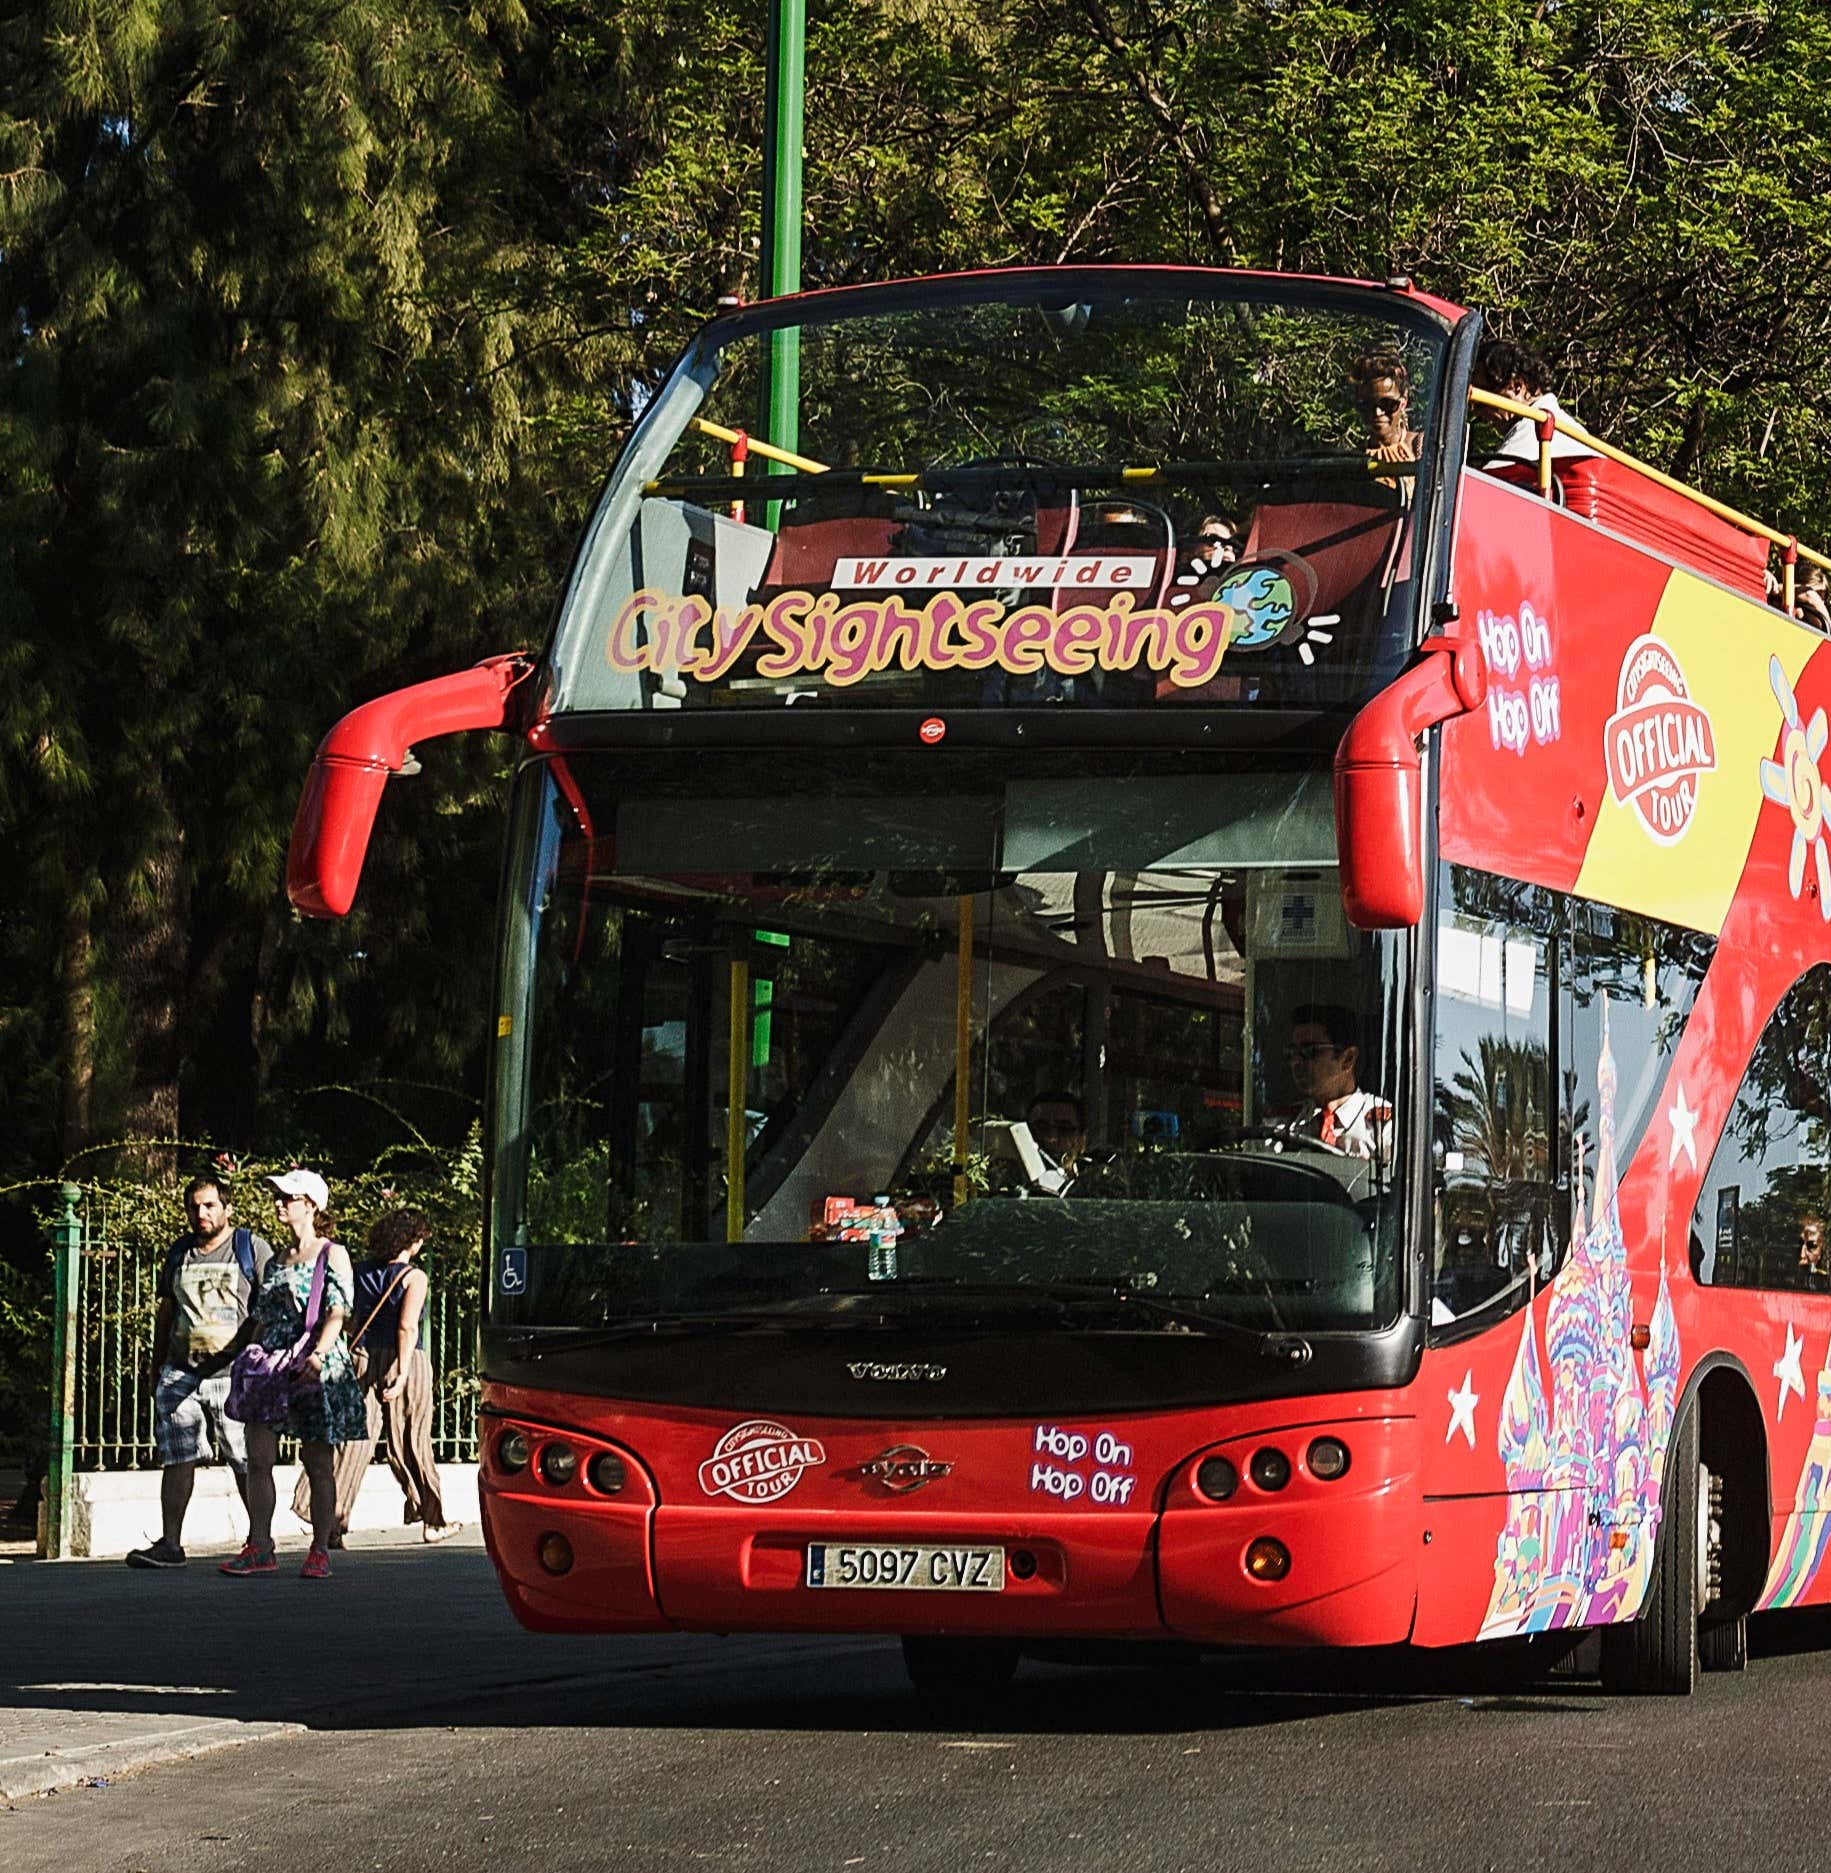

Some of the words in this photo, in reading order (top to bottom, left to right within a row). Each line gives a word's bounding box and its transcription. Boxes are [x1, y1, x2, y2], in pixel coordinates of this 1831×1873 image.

[853, 560, 1132, 584] Worldwide
[1477, 610, 1520, 680] Hop
[1520, 602, 1551, 671] On
[1488, 686, 1530, 756] Hop
[1530, 675, 1560, 745] Off
[1617, 711, 1711, 787] OFFICIAL
[1650, 779, 1694, 831] TOUR
[711, 1442, 818, 1487] OFFICIAL
[1033, 1425, 1089, 1462] Hop
[1095, 1431, 1132, 1466] On
[746, 1471, 795, 1498] TOUR
[1030, 1463, 1085, 1500] Hop
[1090, 1471, 1135, 1505] Off
[840, 1550, 918, 1583] 5097
[930, 1552, 991, 1586] CVZ
